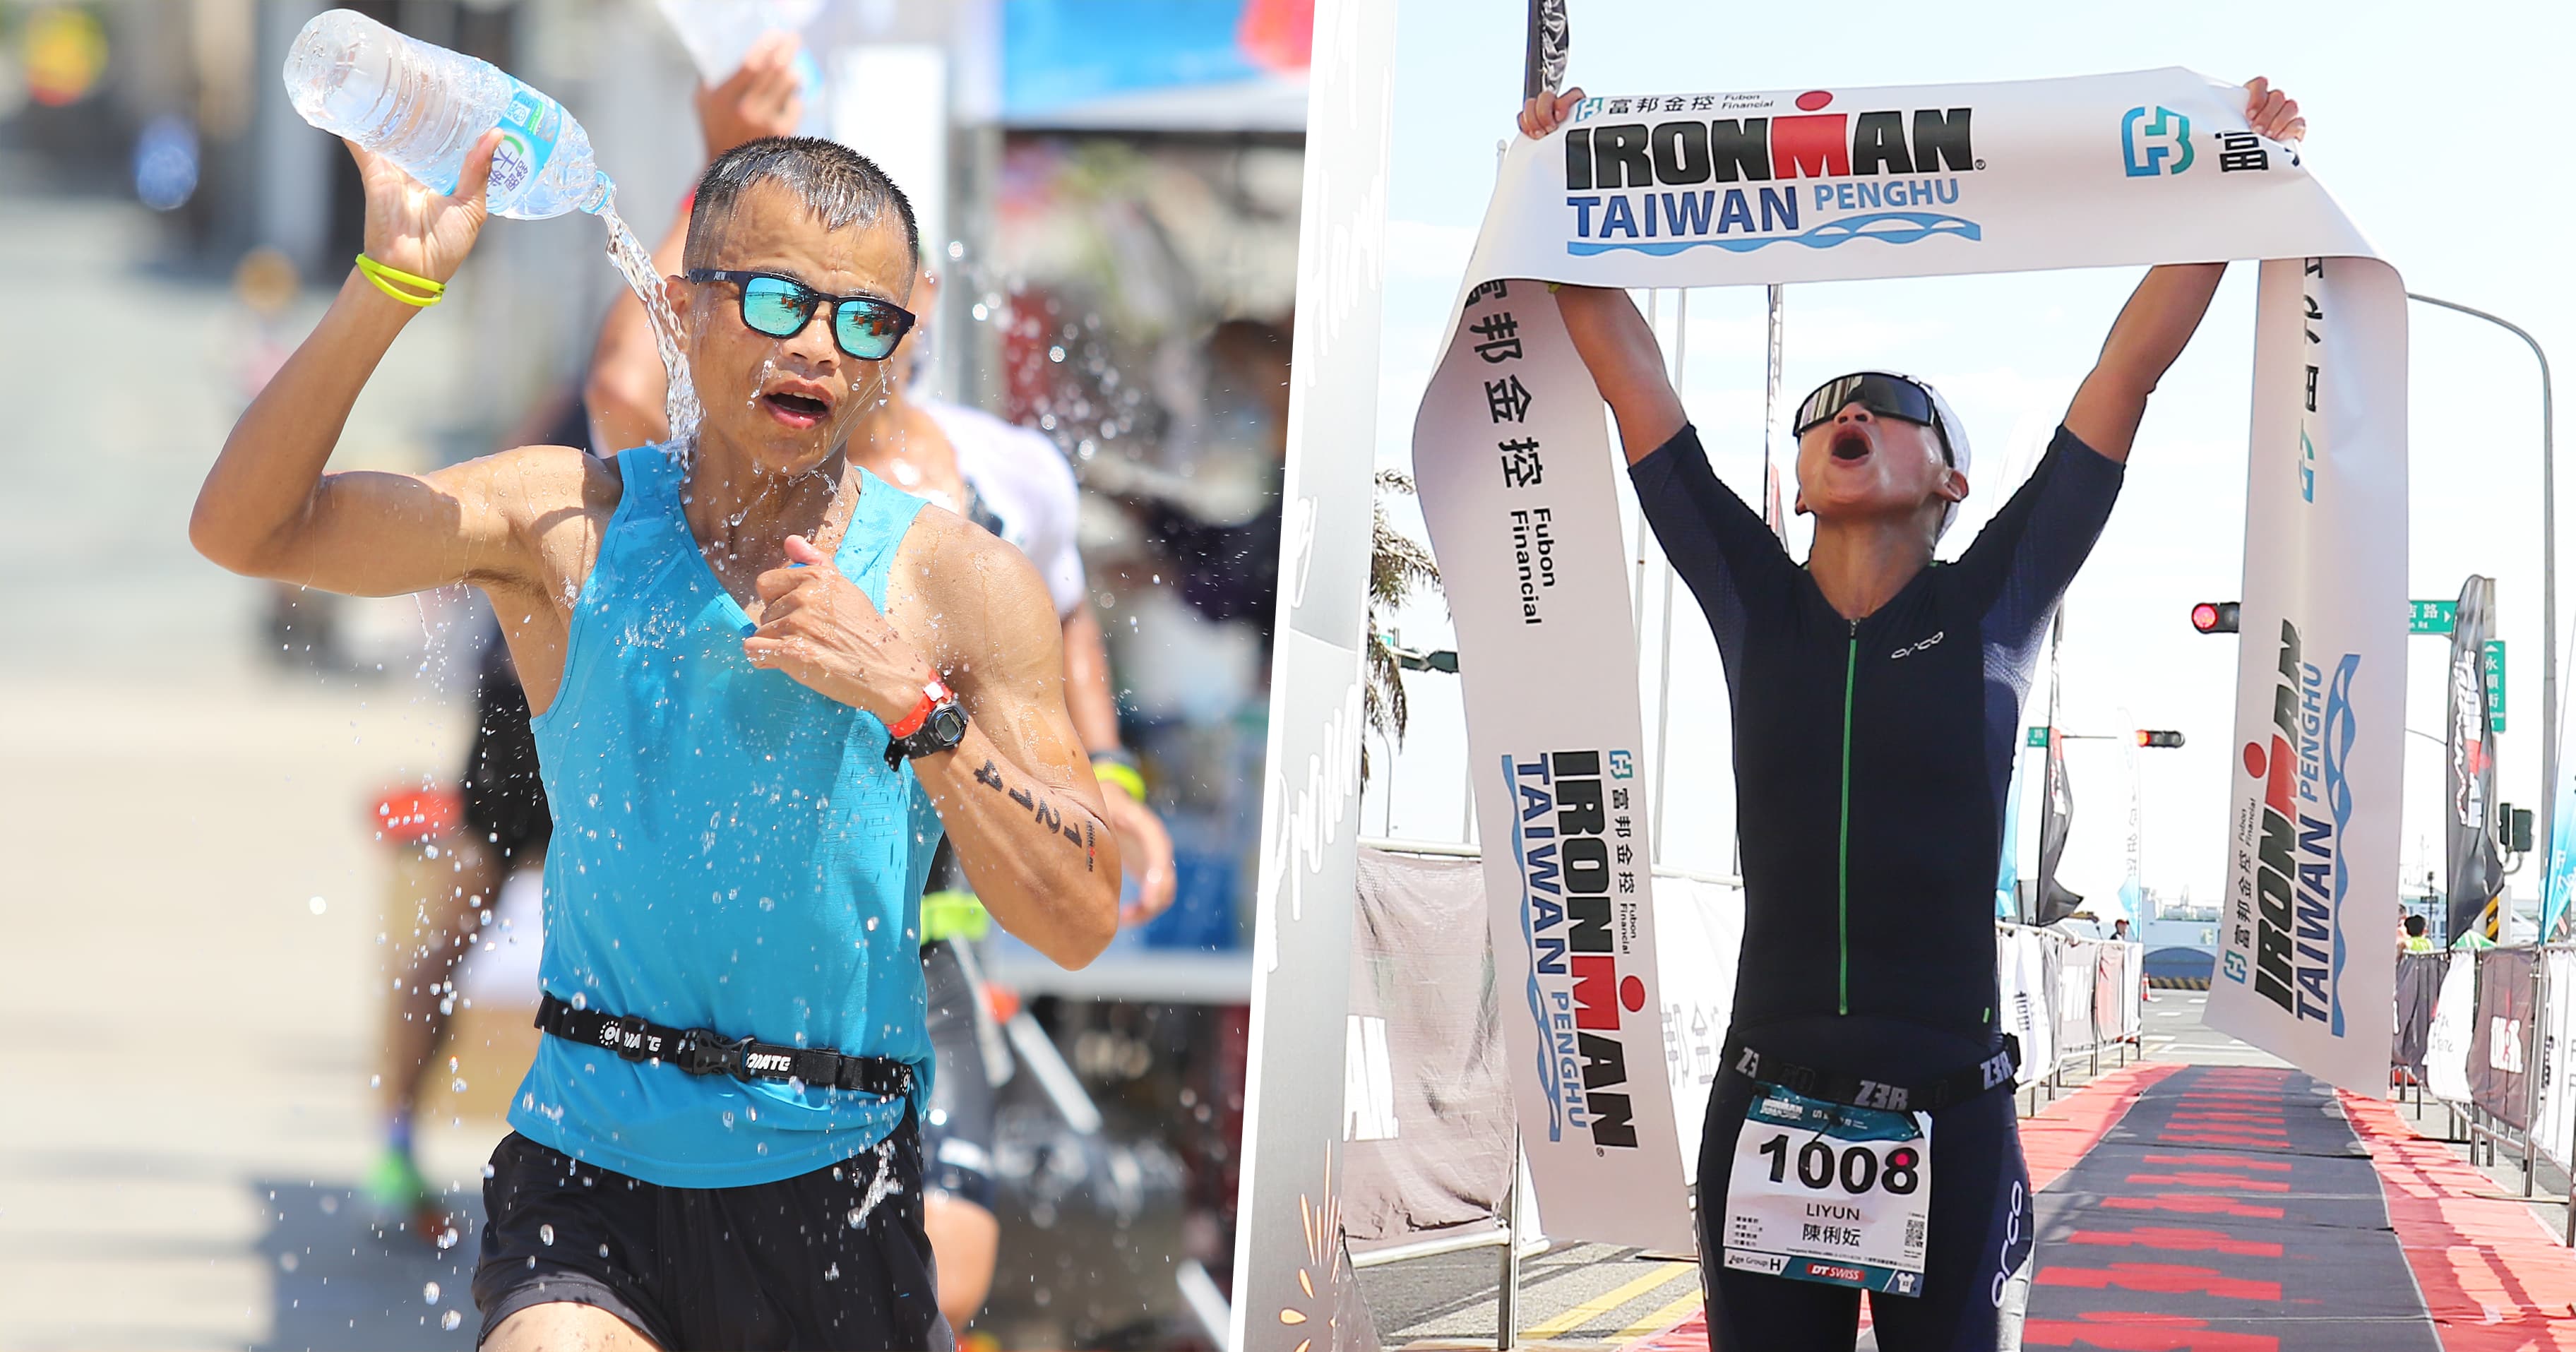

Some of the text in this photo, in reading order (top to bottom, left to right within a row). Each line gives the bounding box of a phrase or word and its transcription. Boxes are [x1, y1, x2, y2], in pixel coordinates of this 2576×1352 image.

[1610, 95, 1715, 114] 富邦金控
[1722, 100, 1774, 110] Financial
[1724, 92, 1760, 102] Fubon
[1566, 90, 1974, 191] IRONMAN
[486, 145, 520, 198] 天然
[1567, 179, 1960, 240] TAIWAN PENGHU
[1510, 510, 1542, 624] Financial
[1533, 508, 1556, 587] Fubon
[1612, 787, 1635, 894] 富邦金控
[2238, 808, 2248, 842] Fubon
[2243, 618, 2301, 1015] IRONMAN
[2245, 798, 2256, 847] Financial
[2296, 663, 2334, 1023] TAIWAN PENGHU
[1628, 903, 1637, 939] Fubon
[2235, 849, 2253, 949] 富邦金控
[1517, 753, 1587, 1128] TAIWAN PENGHU
[1552, 750, 1645, 1148] IRONMAN
[1619, 903, 1630, 955] Financial
[1760, 1135, 1919, 1195] 1008
[1802, 1223, 1861, 1247] 陳俐妘
[1806, 1203, 1860, 1221] LIYUN
[1770, 1258, 1781, 1271] H
[1811, 1265, 1860, 1281] DT SWISS
